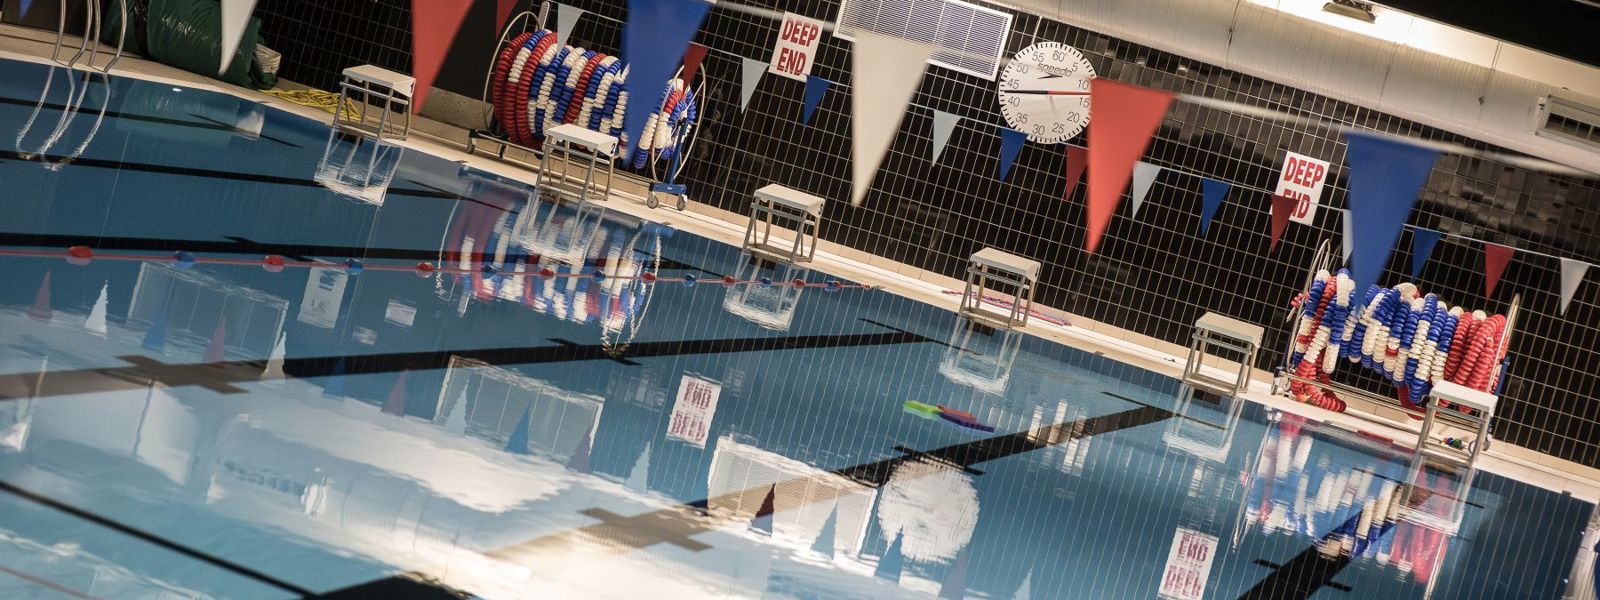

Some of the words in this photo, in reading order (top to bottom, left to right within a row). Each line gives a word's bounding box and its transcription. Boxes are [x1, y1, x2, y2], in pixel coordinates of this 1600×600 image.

[781, 17, 819, 47] DEEP
[777, 47, 806, 76] END
[1032, 51, 1045, 63] 55
[1052, 50, 1065, 62] 60
[1016, 63, 1029, 74] 50
[1037, 63, 1073, 77] speedo
[1071, 61, 1079, 72] 5
[1007, 78, 1020, 89] 45
[1078, 79, 1090, 90] 10
[1008, 96, 1020, 107] 40
[1079, 97, 1090, 108] 15
[1015, 112, 1028, 124] 35
[1067, 111, 1080, 124] 20
[1032, 124, 1045, 136] 30
[1052, 122, 1065, 134] 25
[1283, 157, 1325, 188] DEEP
